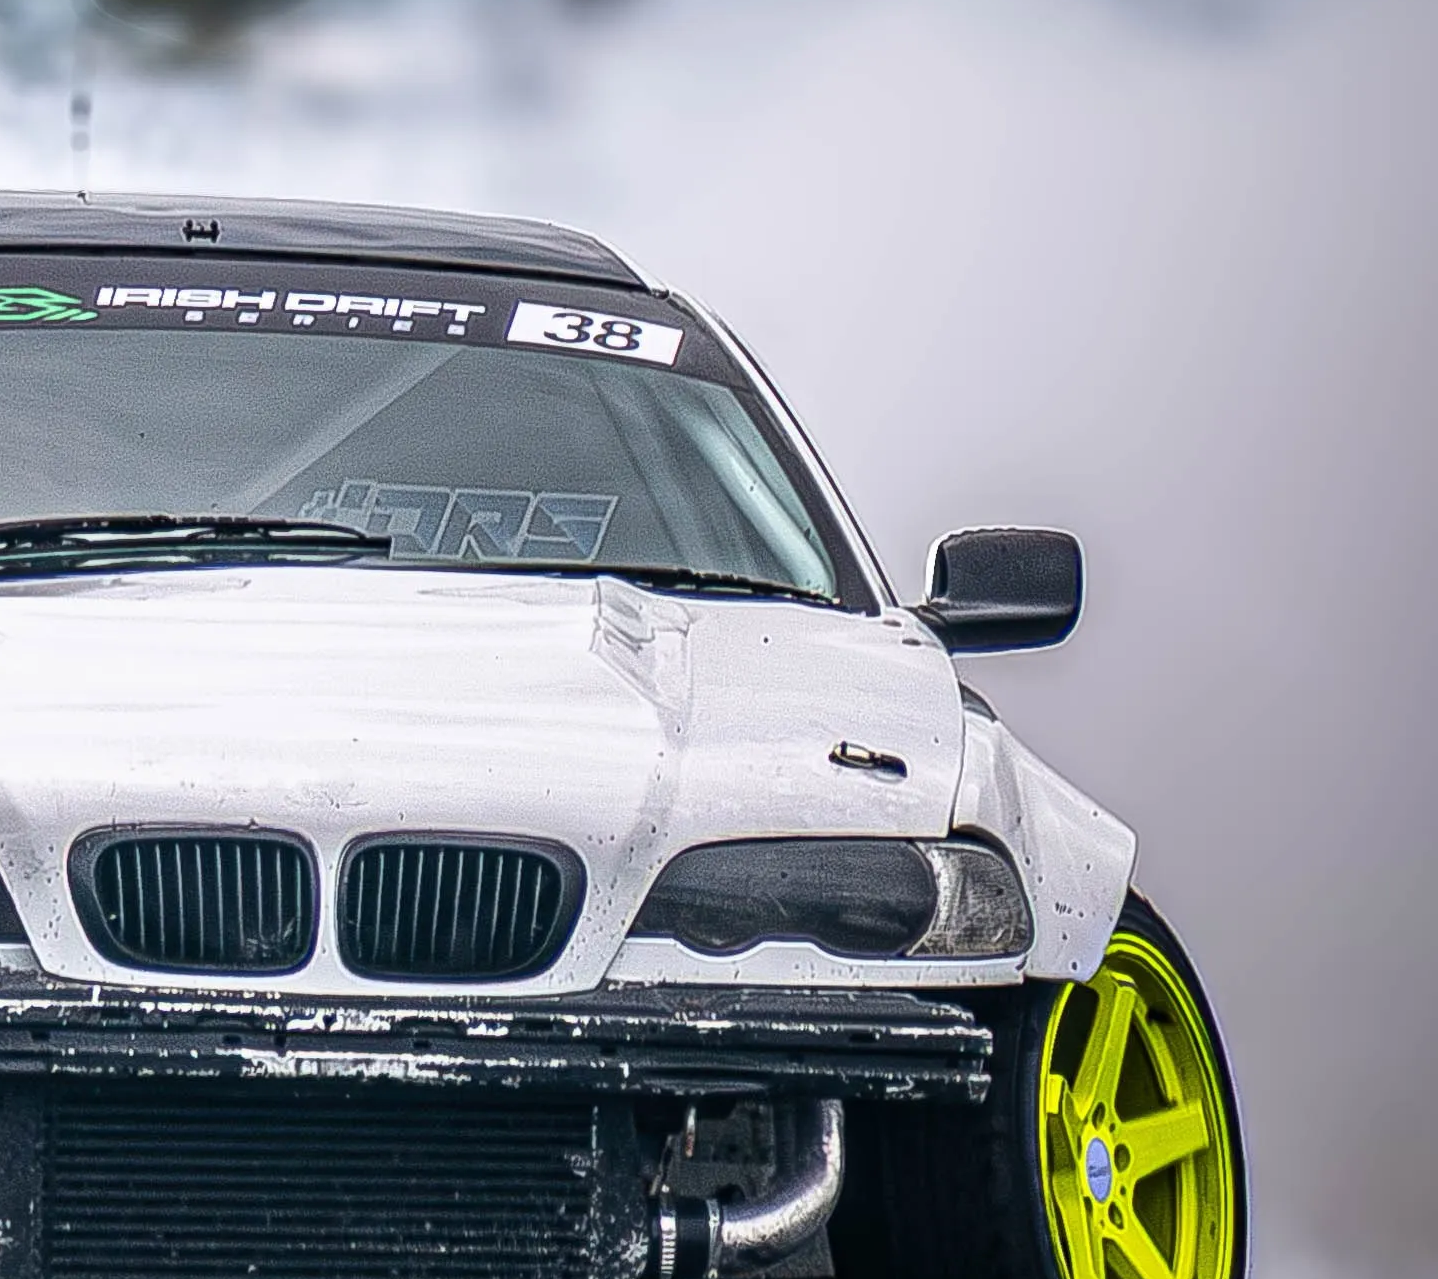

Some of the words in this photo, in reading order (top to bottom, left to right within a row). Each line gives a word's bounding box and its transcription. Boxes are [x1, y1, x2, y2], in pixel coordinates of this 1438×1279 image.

[96, 286, 277, 309] IRISH
[285, 291, 486, 322] DRIFT
[544, 312, 642, 352] 38
